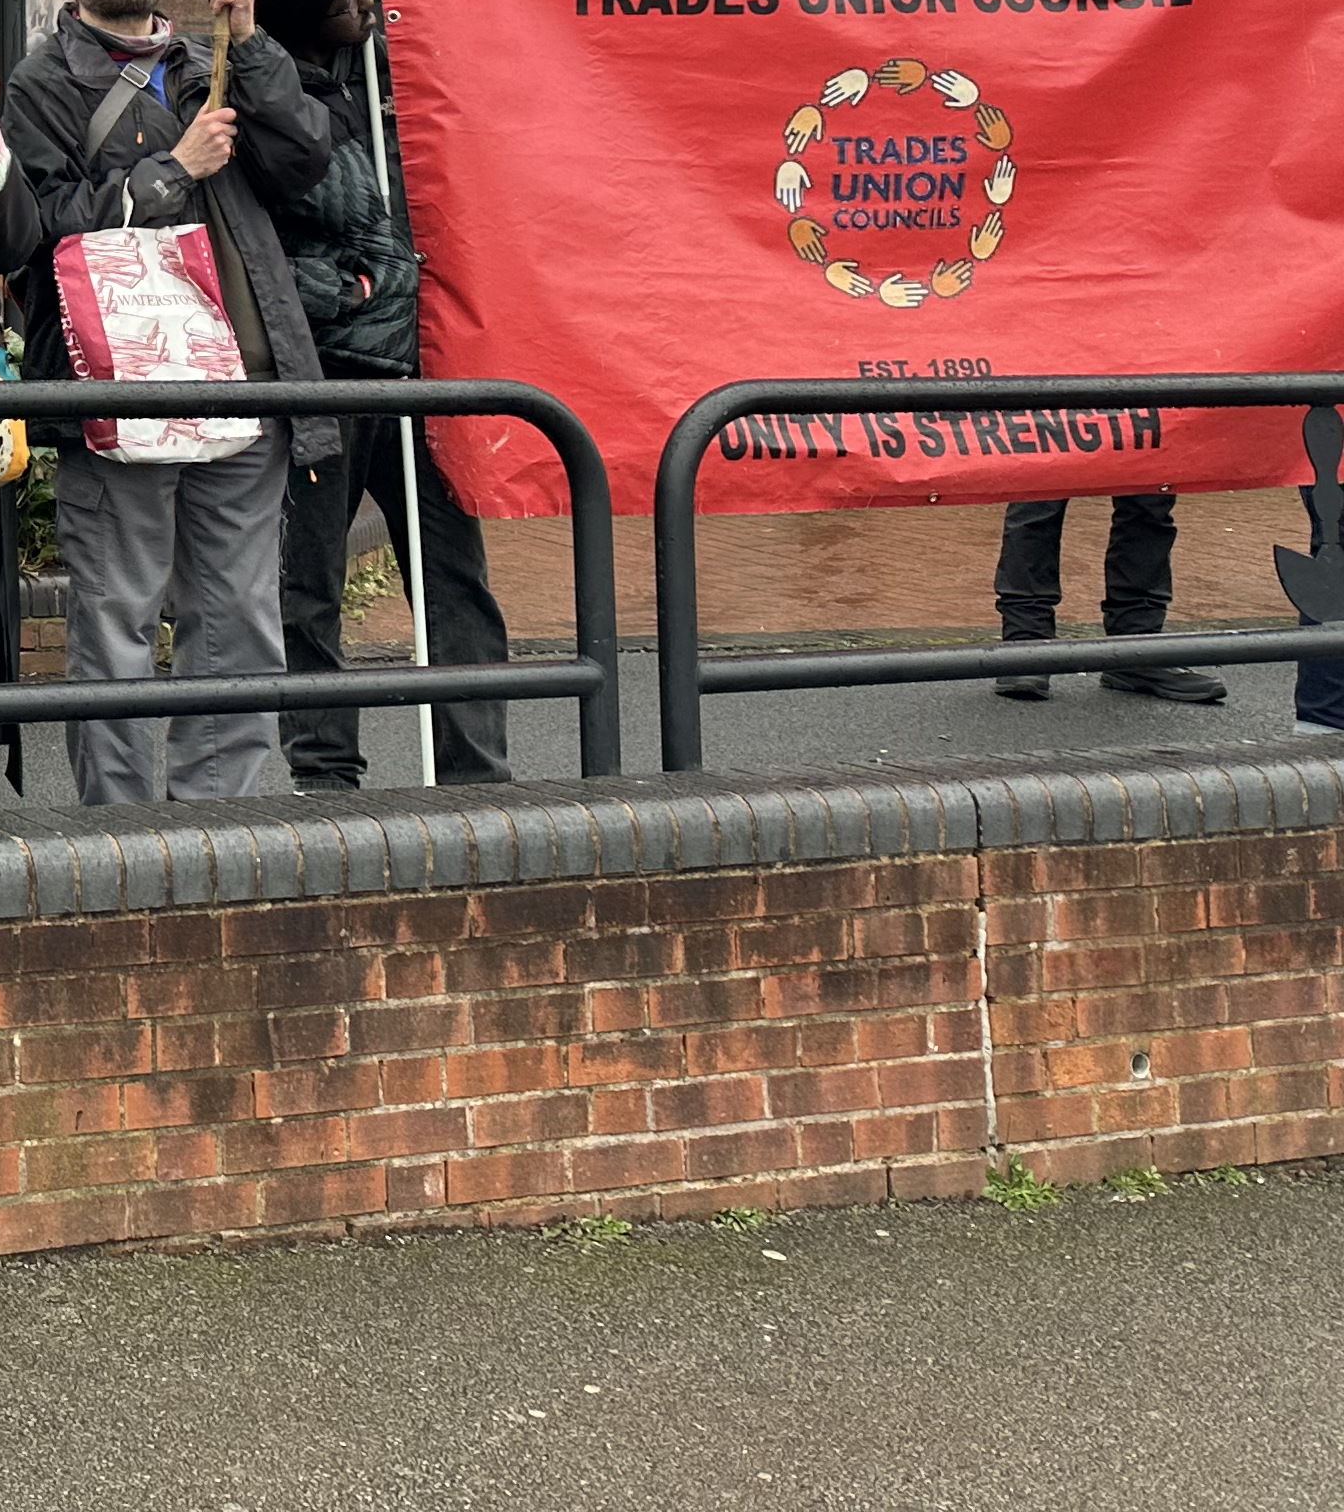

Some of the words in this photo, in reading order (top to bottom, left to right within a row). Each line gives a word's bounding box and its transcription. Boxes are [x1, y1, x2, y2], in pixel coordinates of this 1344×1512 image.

[831, 136, 968, 164] TRADES
[832, 172, 966, 202] UNION
[832, 206, 961, 230] COUNCILS
[858, 360, 918, 379] EST.
[927, 357, 992, 378] 1890
[718, 413, 848, 461] UNITY
[859, 412, 906, 459] IS
[918, 408, 1161, 459] STRENGTH
